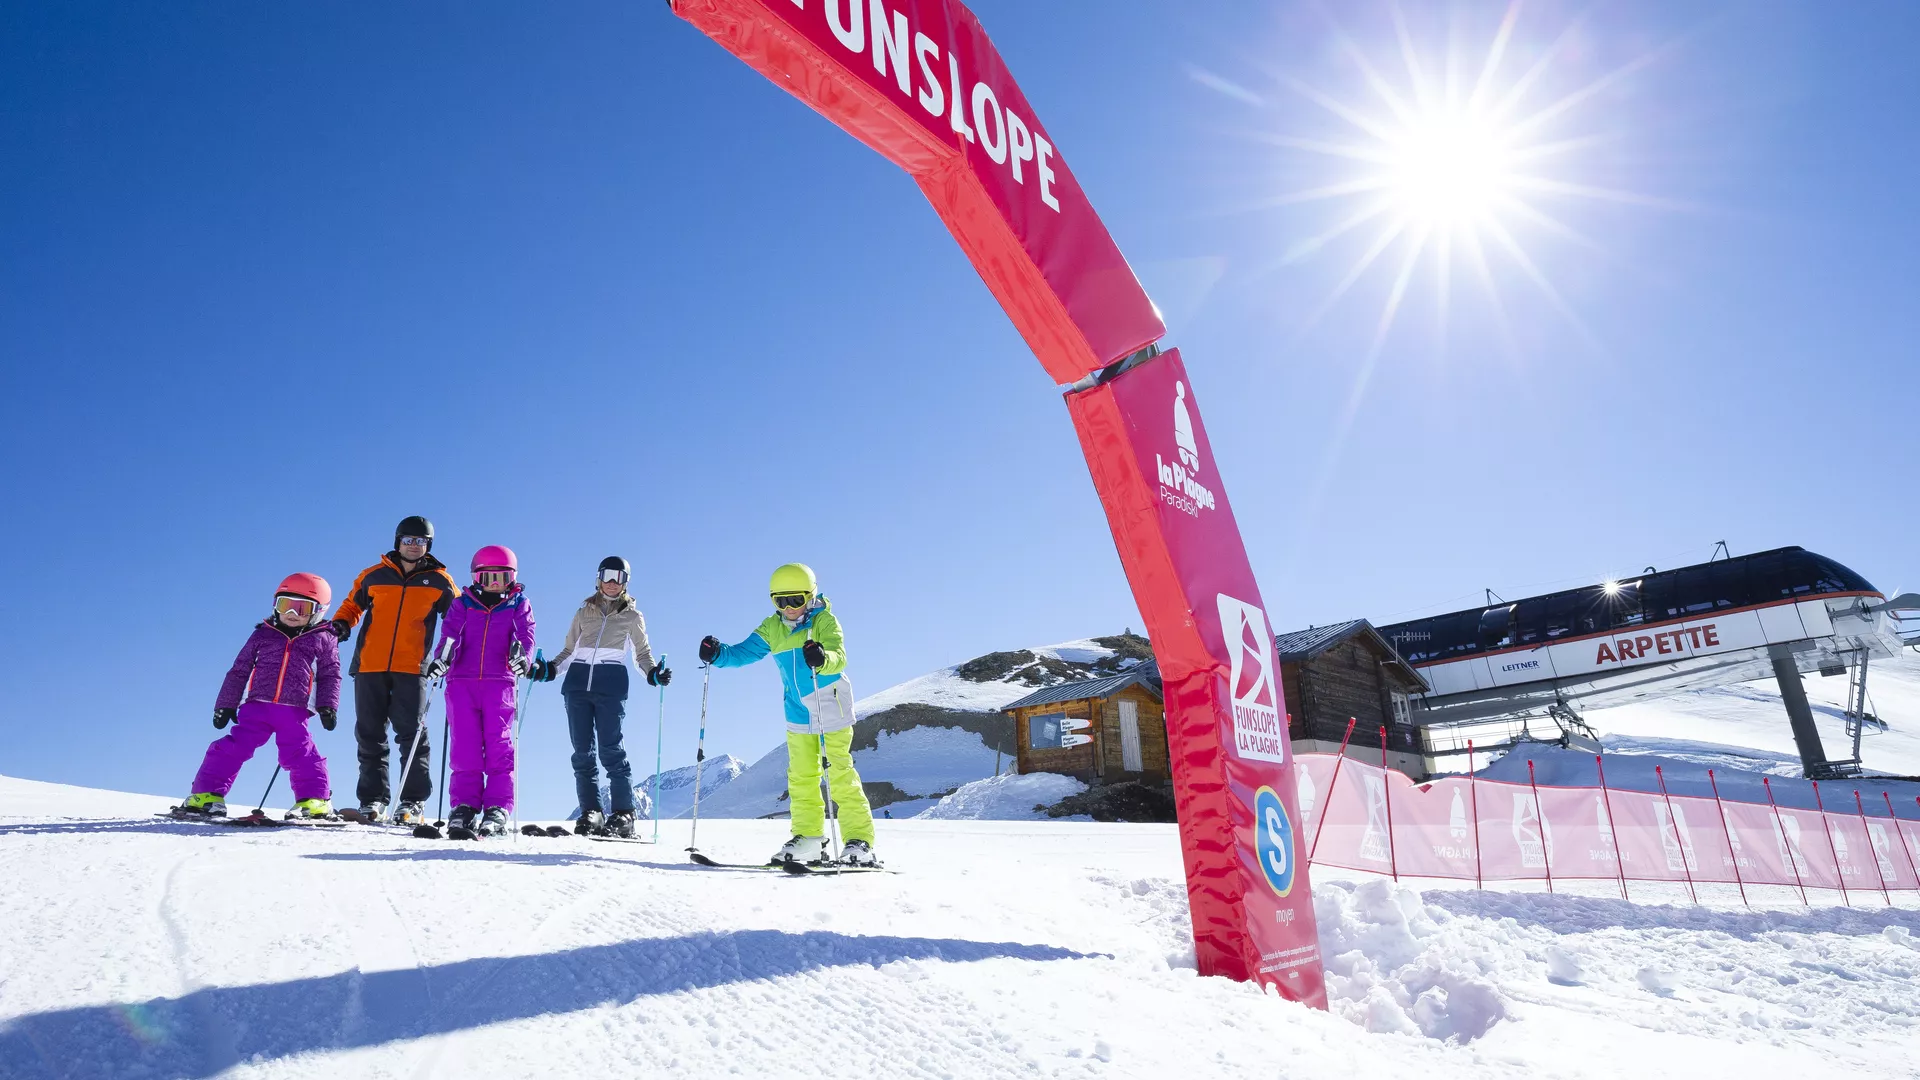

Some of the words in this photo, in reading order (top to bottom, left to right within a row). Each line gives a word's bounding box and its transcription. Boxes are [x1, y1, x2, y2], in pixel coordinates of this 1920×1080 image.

[790, 0, 1060, 213] UNSLOPE
[1160, 485, 1199, 518] Paradiski
[1172, 461, 1216, 511] Plagne
[1596, 624, 1720, 665] ARPETTE
[1502, 660, 1539, 672] LEITNER
[1235, 705, 1277, 735] FUNSLOPE
[1238, 732, 1250, 751] LA
[1250, 734, 1280, 756] PLAGNE
[1265, 806, 1287, 875] S
[1275, 908, 1295, 926] moyen
